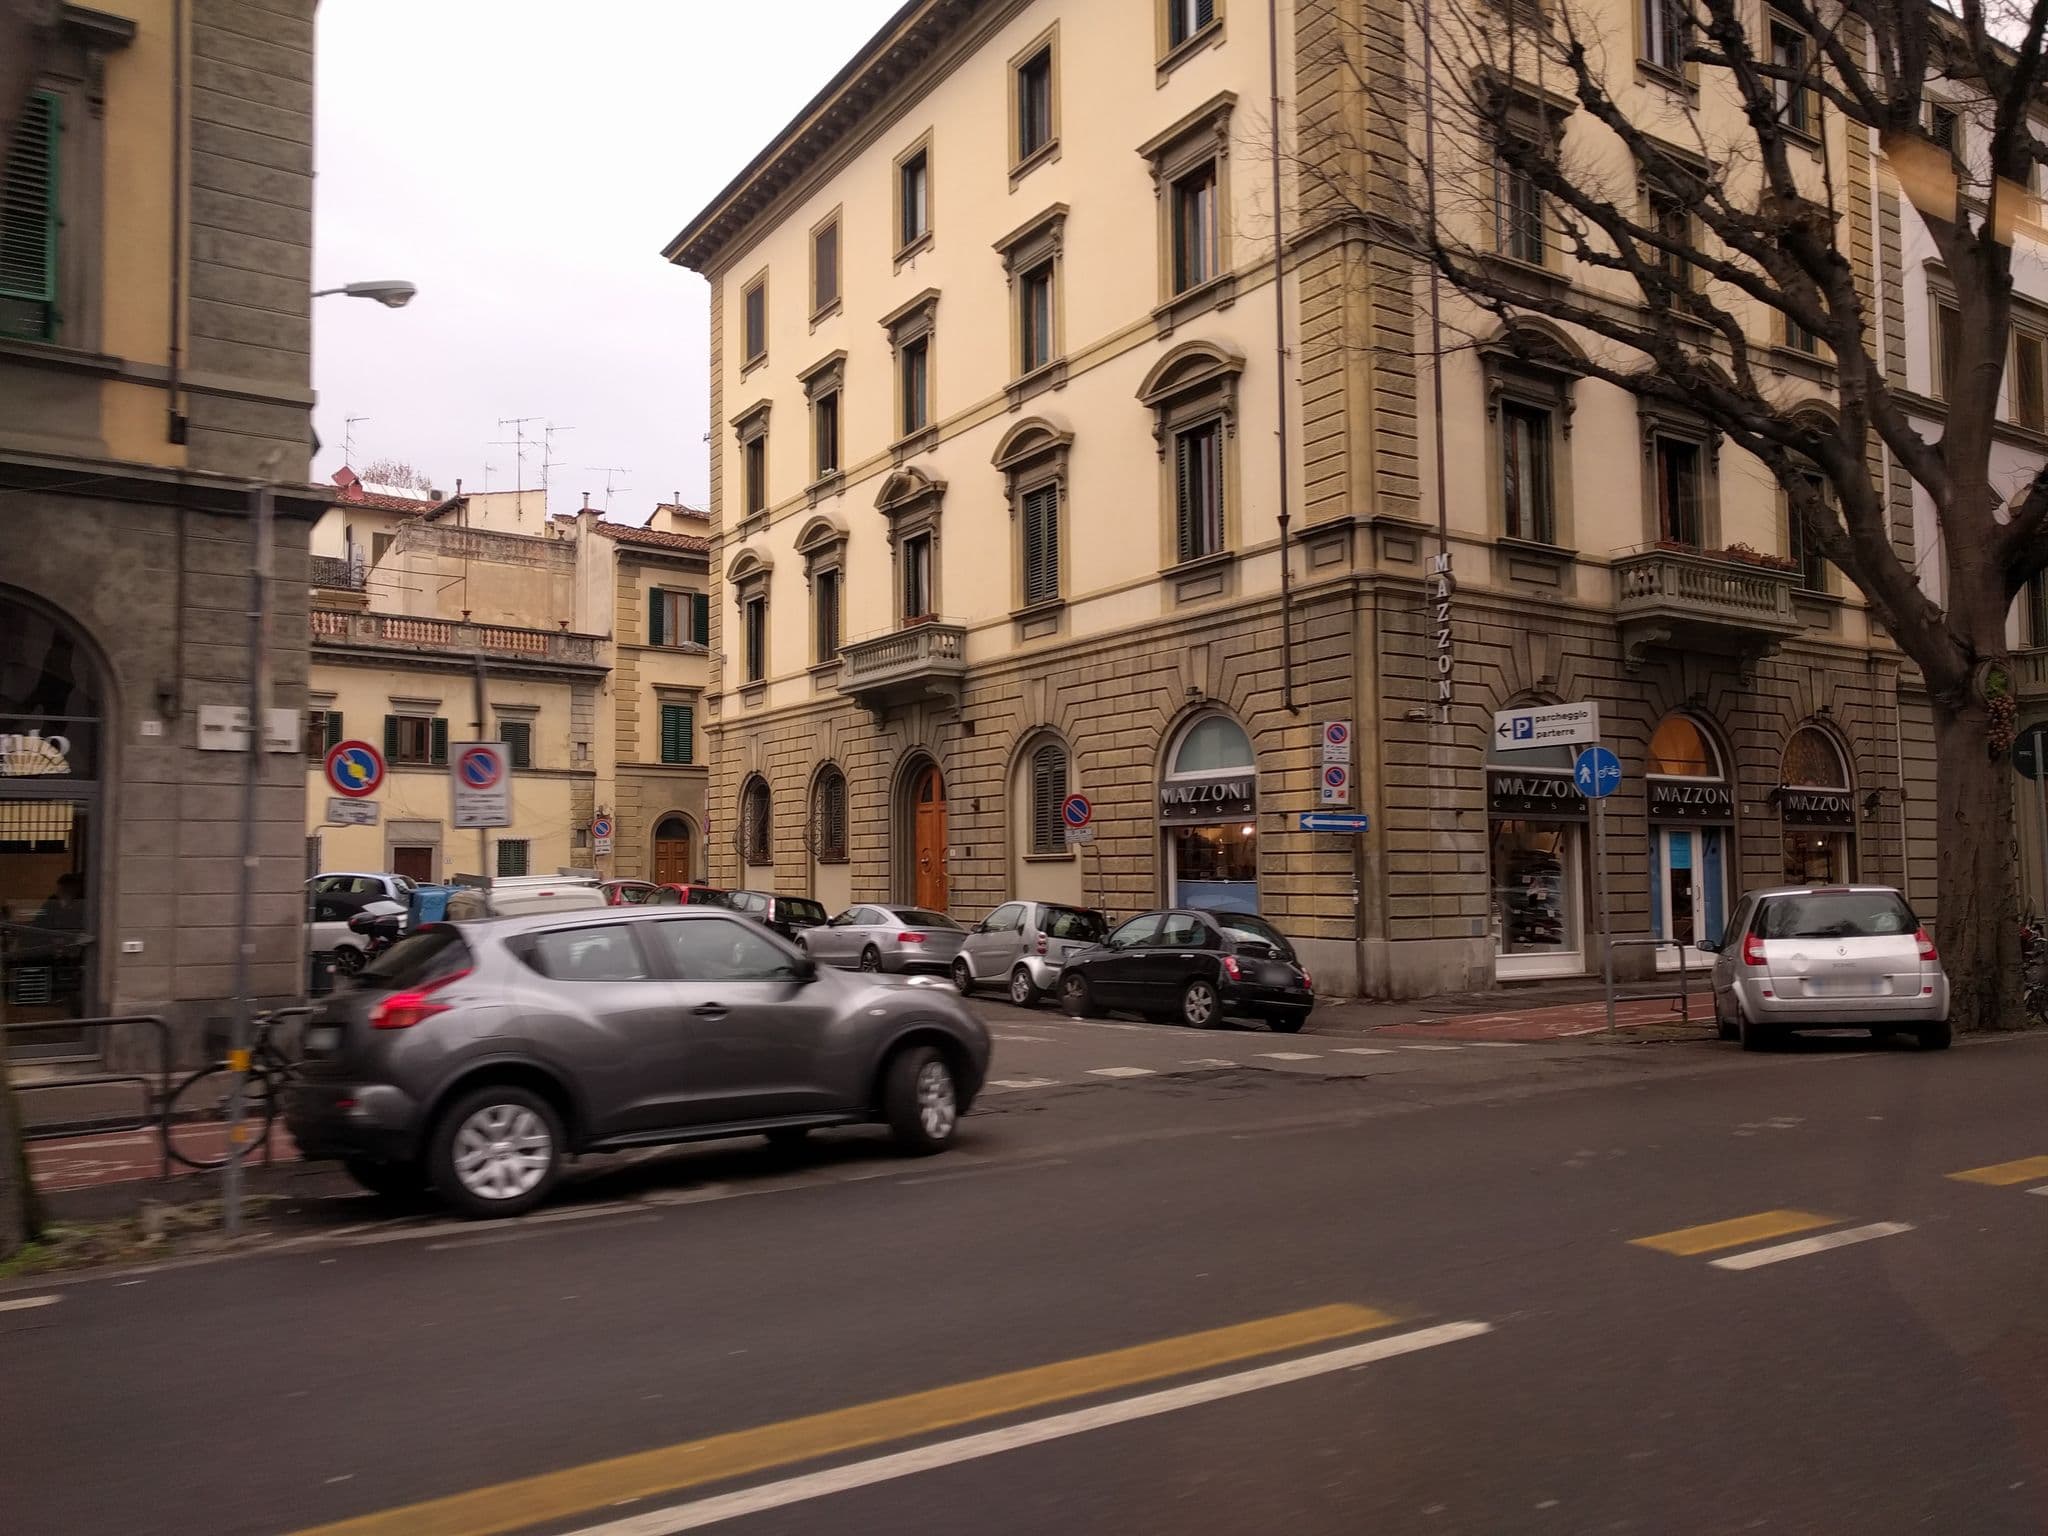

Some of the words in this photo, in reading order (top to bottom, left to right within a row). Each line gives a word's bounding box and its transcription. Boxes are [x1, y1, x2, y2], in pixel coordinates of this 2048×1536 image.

[1433, 552, 1452, 725] MAZZONI
[1535, 709, 1589, 723] parcheggio
[1535, 728, 1576, 739] parterre
[1160, 782, 1251, 804] MAZZONI
[1494, 778, 1587, 798] MAZZON
[1656, 786, 1736, 804] MAZZONI
[1788, 795, 1856, 813] MAZZONI
